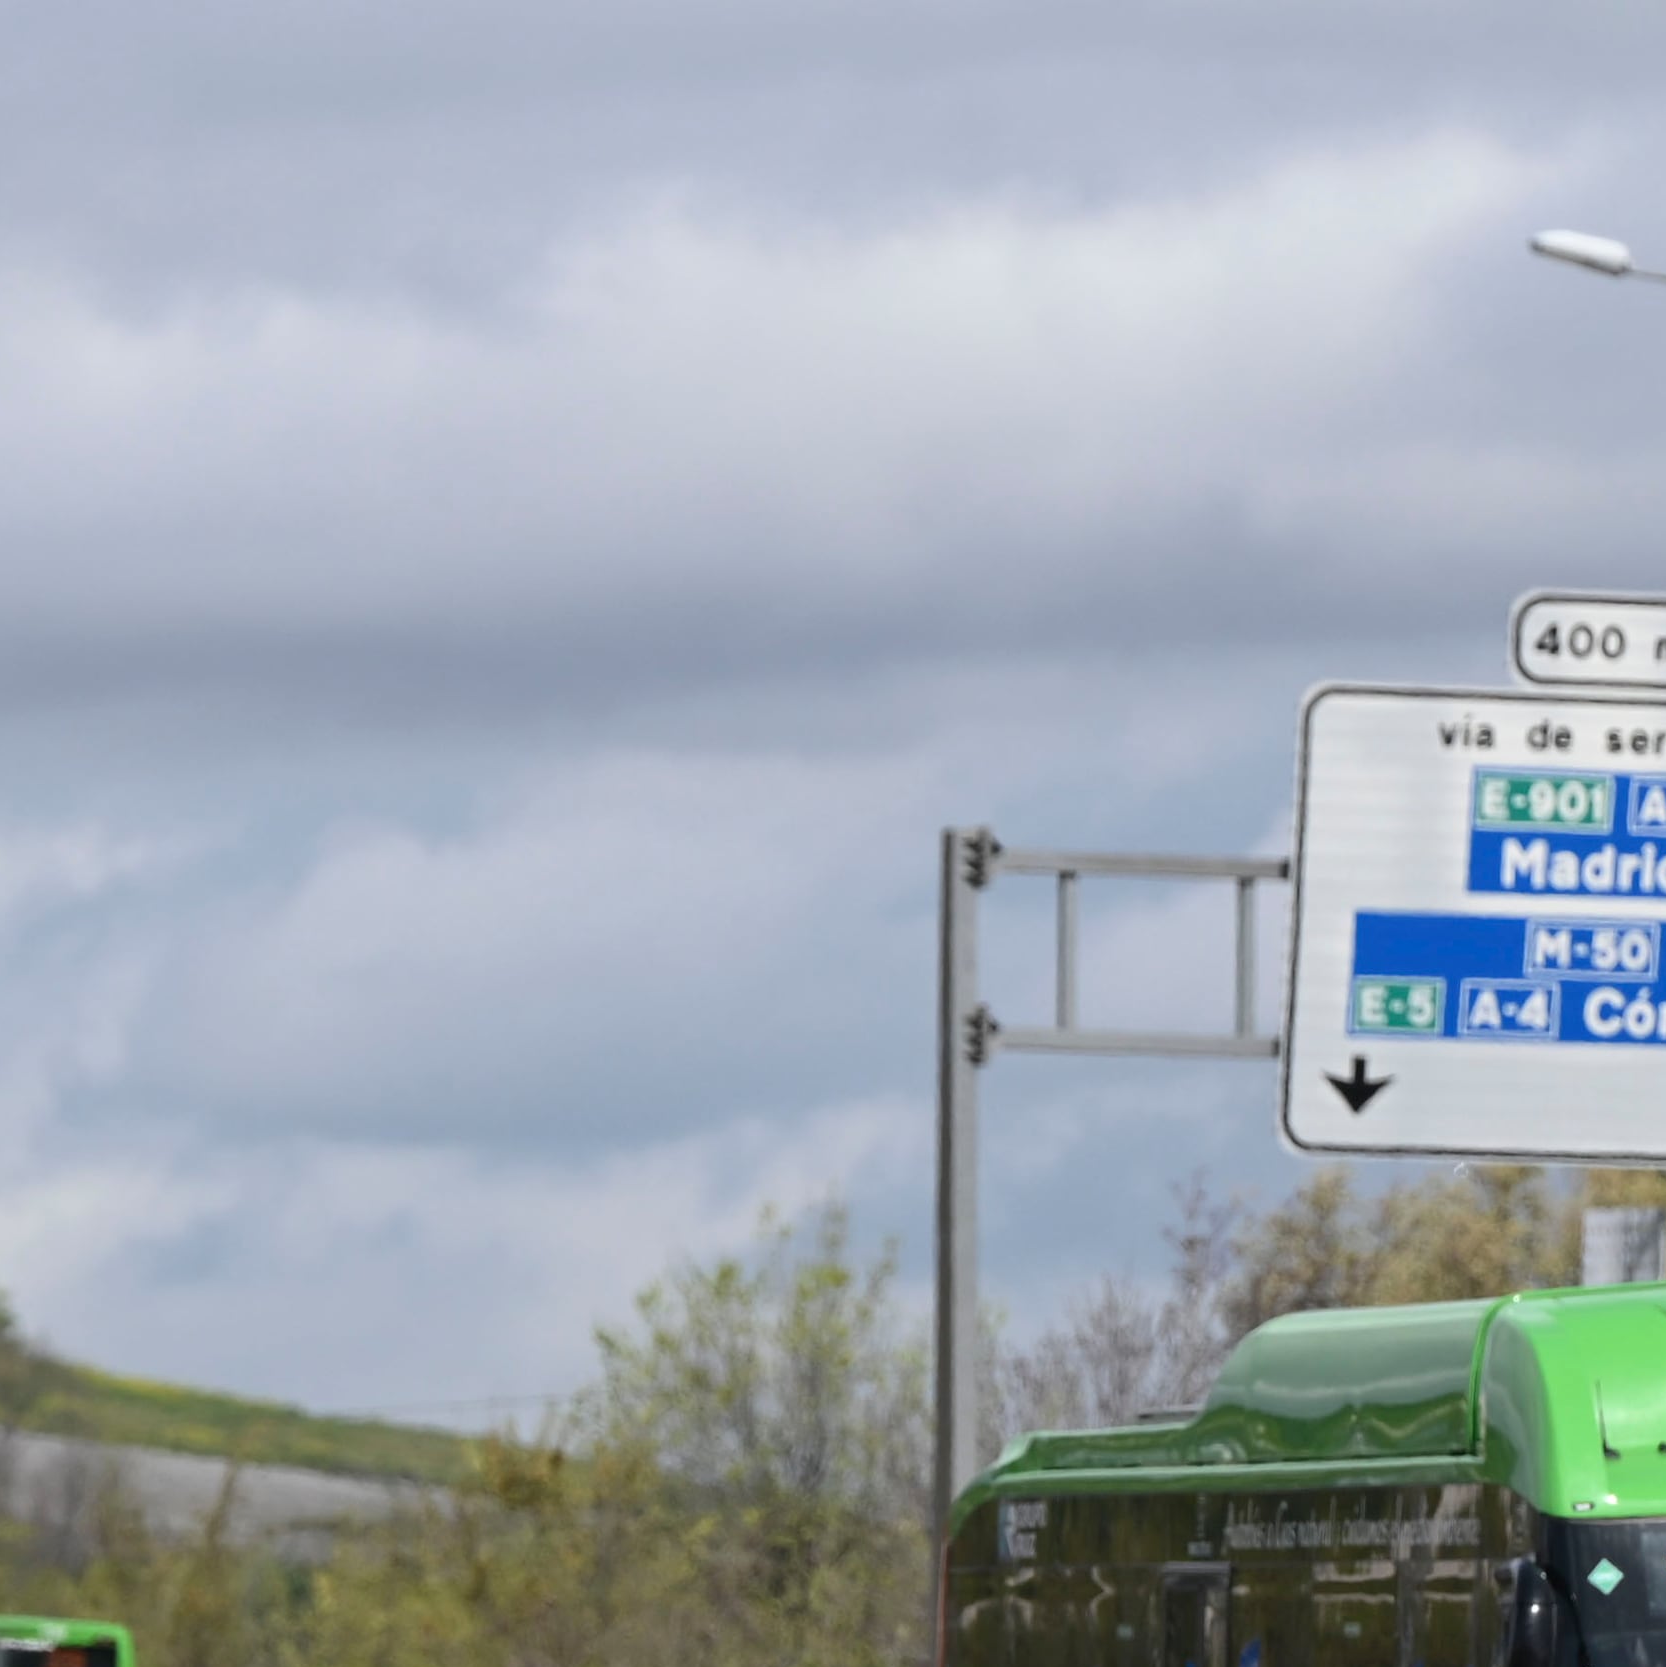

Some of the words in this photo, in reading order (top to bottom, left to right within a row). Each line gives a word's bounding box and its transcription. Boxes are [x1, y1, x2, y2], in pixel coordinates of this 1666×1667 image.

[1534, 625, 1626, 661] 400
[1527, 718, 1573, 751] de
[1480, 776, 1607, 823] E-901
[1534, 927, 1652, 972] M-50
[1358, 984, 1436, 1027] E-5
[1467, 988, 1551, 1029] A-4
